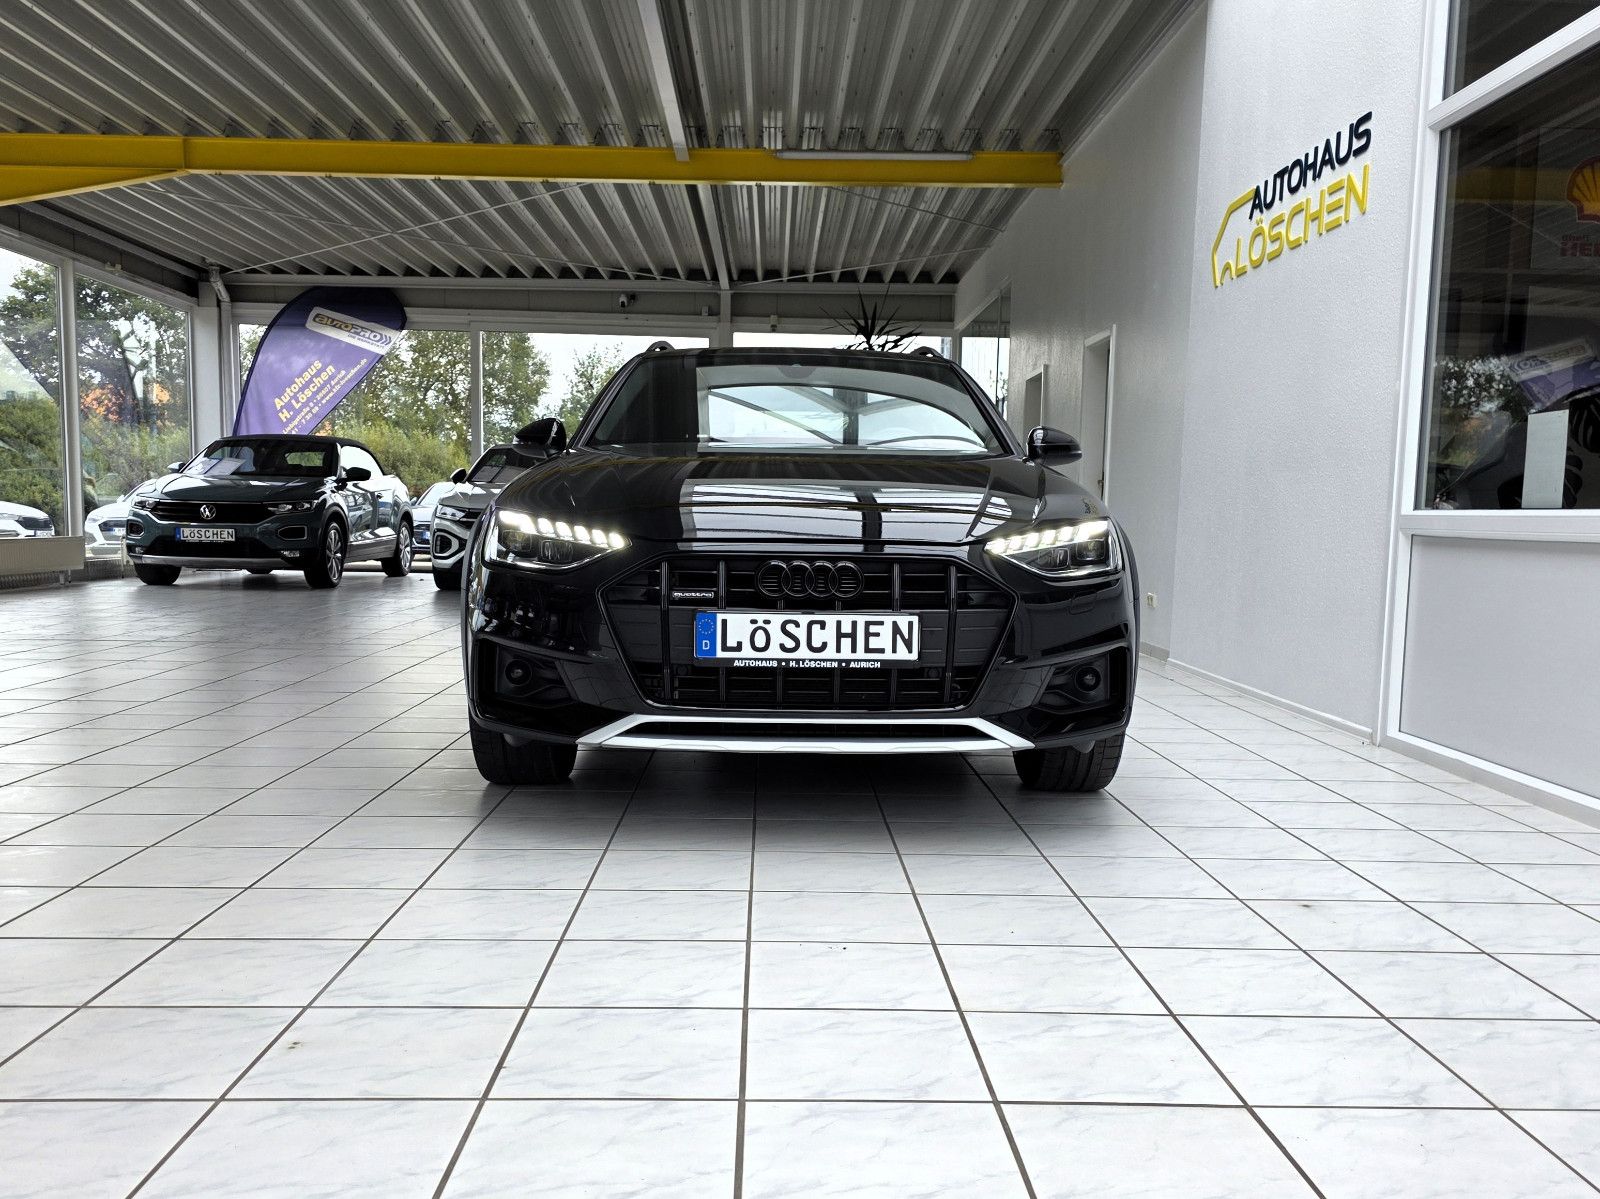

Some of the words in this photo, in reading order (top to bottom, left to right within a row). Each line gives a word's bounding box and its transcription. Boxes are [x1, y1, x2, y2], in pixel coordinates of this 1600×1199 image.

[1249, 111, 1372, 220] AUTOHAUS
[1235, 163, 1370, 278] LÖSCHEN
[274, 360, 322, 410] Autohaus
[278, 408, 293, 422] H.
[291, 365, 336, 409] Löschen
[182, 529, 234, 539] LÖSCHEN
[673, 592, 712, 600] quattro
[703, 640, 710, 649] D
[721, 619, 914, 653] LÖSCHEN
[733, 659, 778, 667] AUTOHAUS
[800, 659, 838, 668] LÖSCHEN
